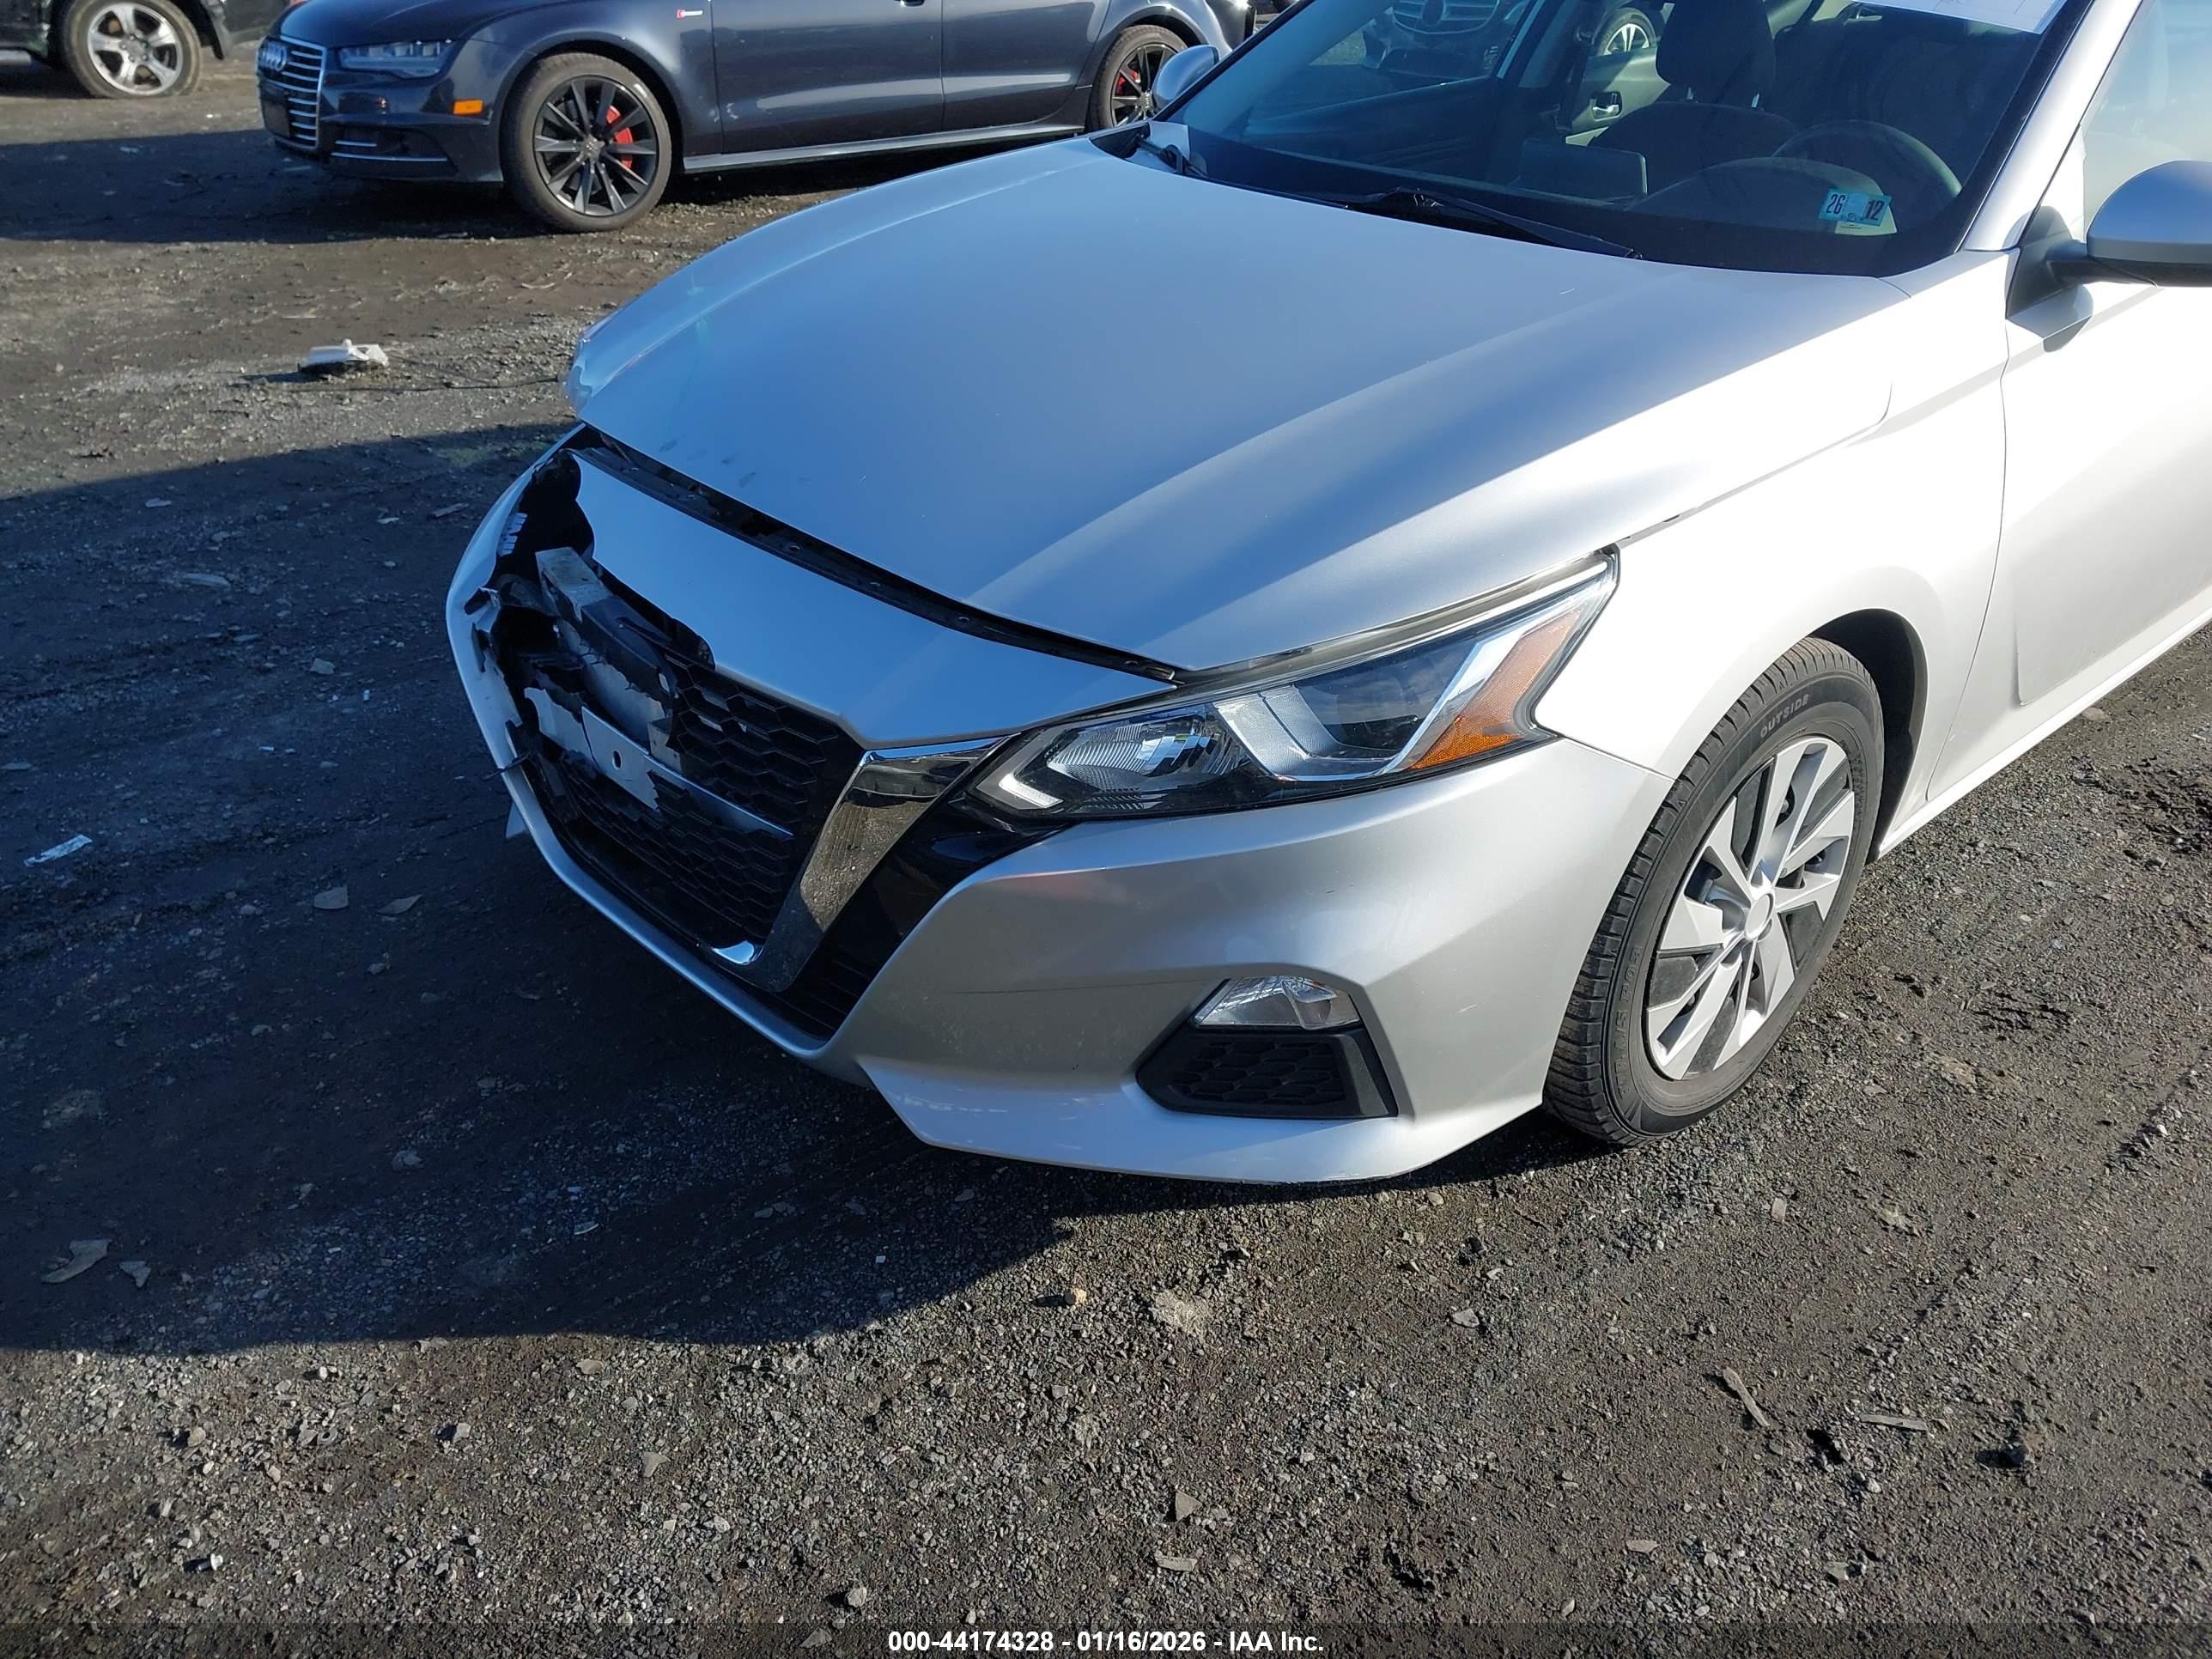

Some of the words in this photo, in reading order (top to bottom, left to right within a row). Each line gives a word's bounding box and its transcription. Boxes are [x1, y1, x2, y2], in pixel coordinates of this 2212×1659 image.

[1826, 194, 1845, 214] 26
[1865, 200, 1885, 220] 12
[1760, 694, 1808, 738] OUTSIDE
